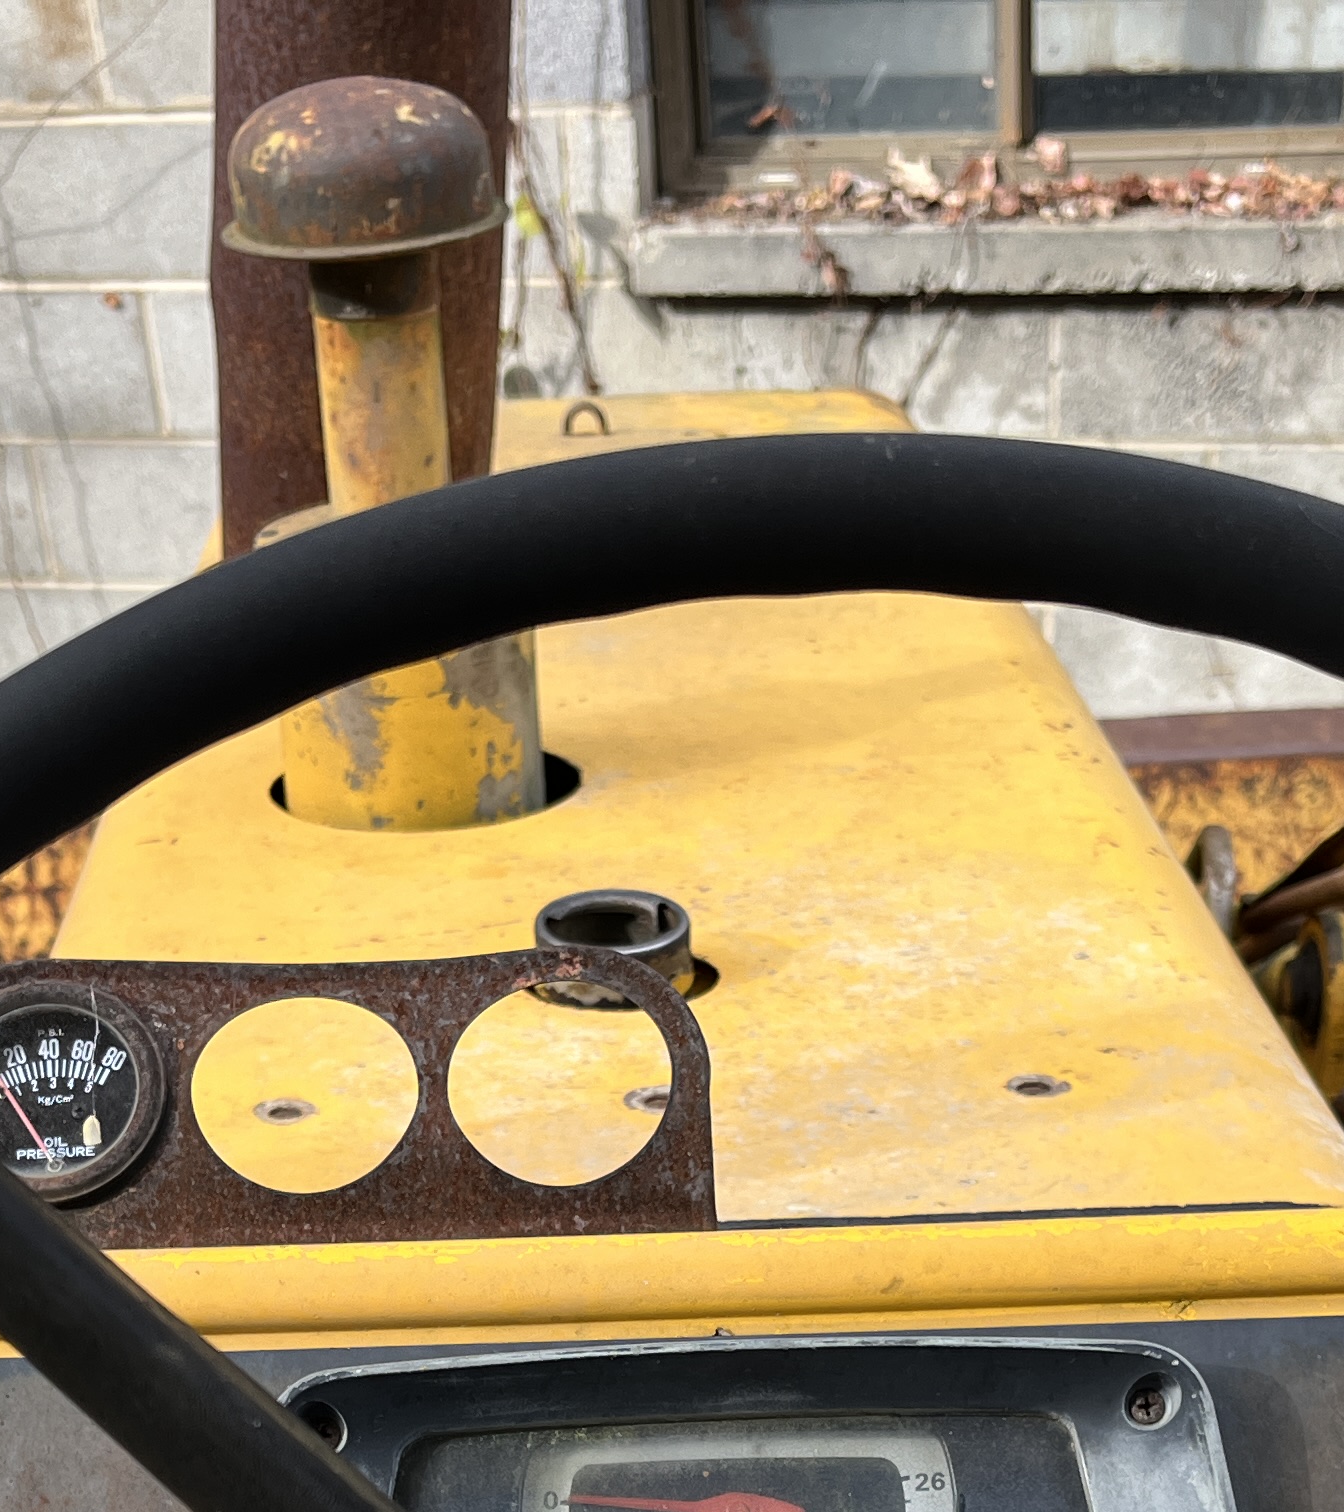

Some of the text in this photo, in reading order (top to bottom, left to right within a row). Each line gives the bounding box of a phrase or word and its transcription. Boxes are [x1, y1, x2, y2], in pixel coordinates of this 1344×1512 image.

[3, 1044, 27, 1068] 20
[38, 1038, 60, 1060] 40
[71, 1039, 94, 1061] 60
[102, 1046, 127, 1071] 80
[15, 1084, 22, 1097] 1
[31, 1079, 39, 1092] 2
[49, 1077, 57, 1089] 3
[67, 1077, 75, 1090] 4
[44, 1137, 68, 1148] OIL
[16, 1146, 96, 1160] PRESSURE
[915, 1473, 946, 1490] 26
[543, 1492, 557, 1510] 0
